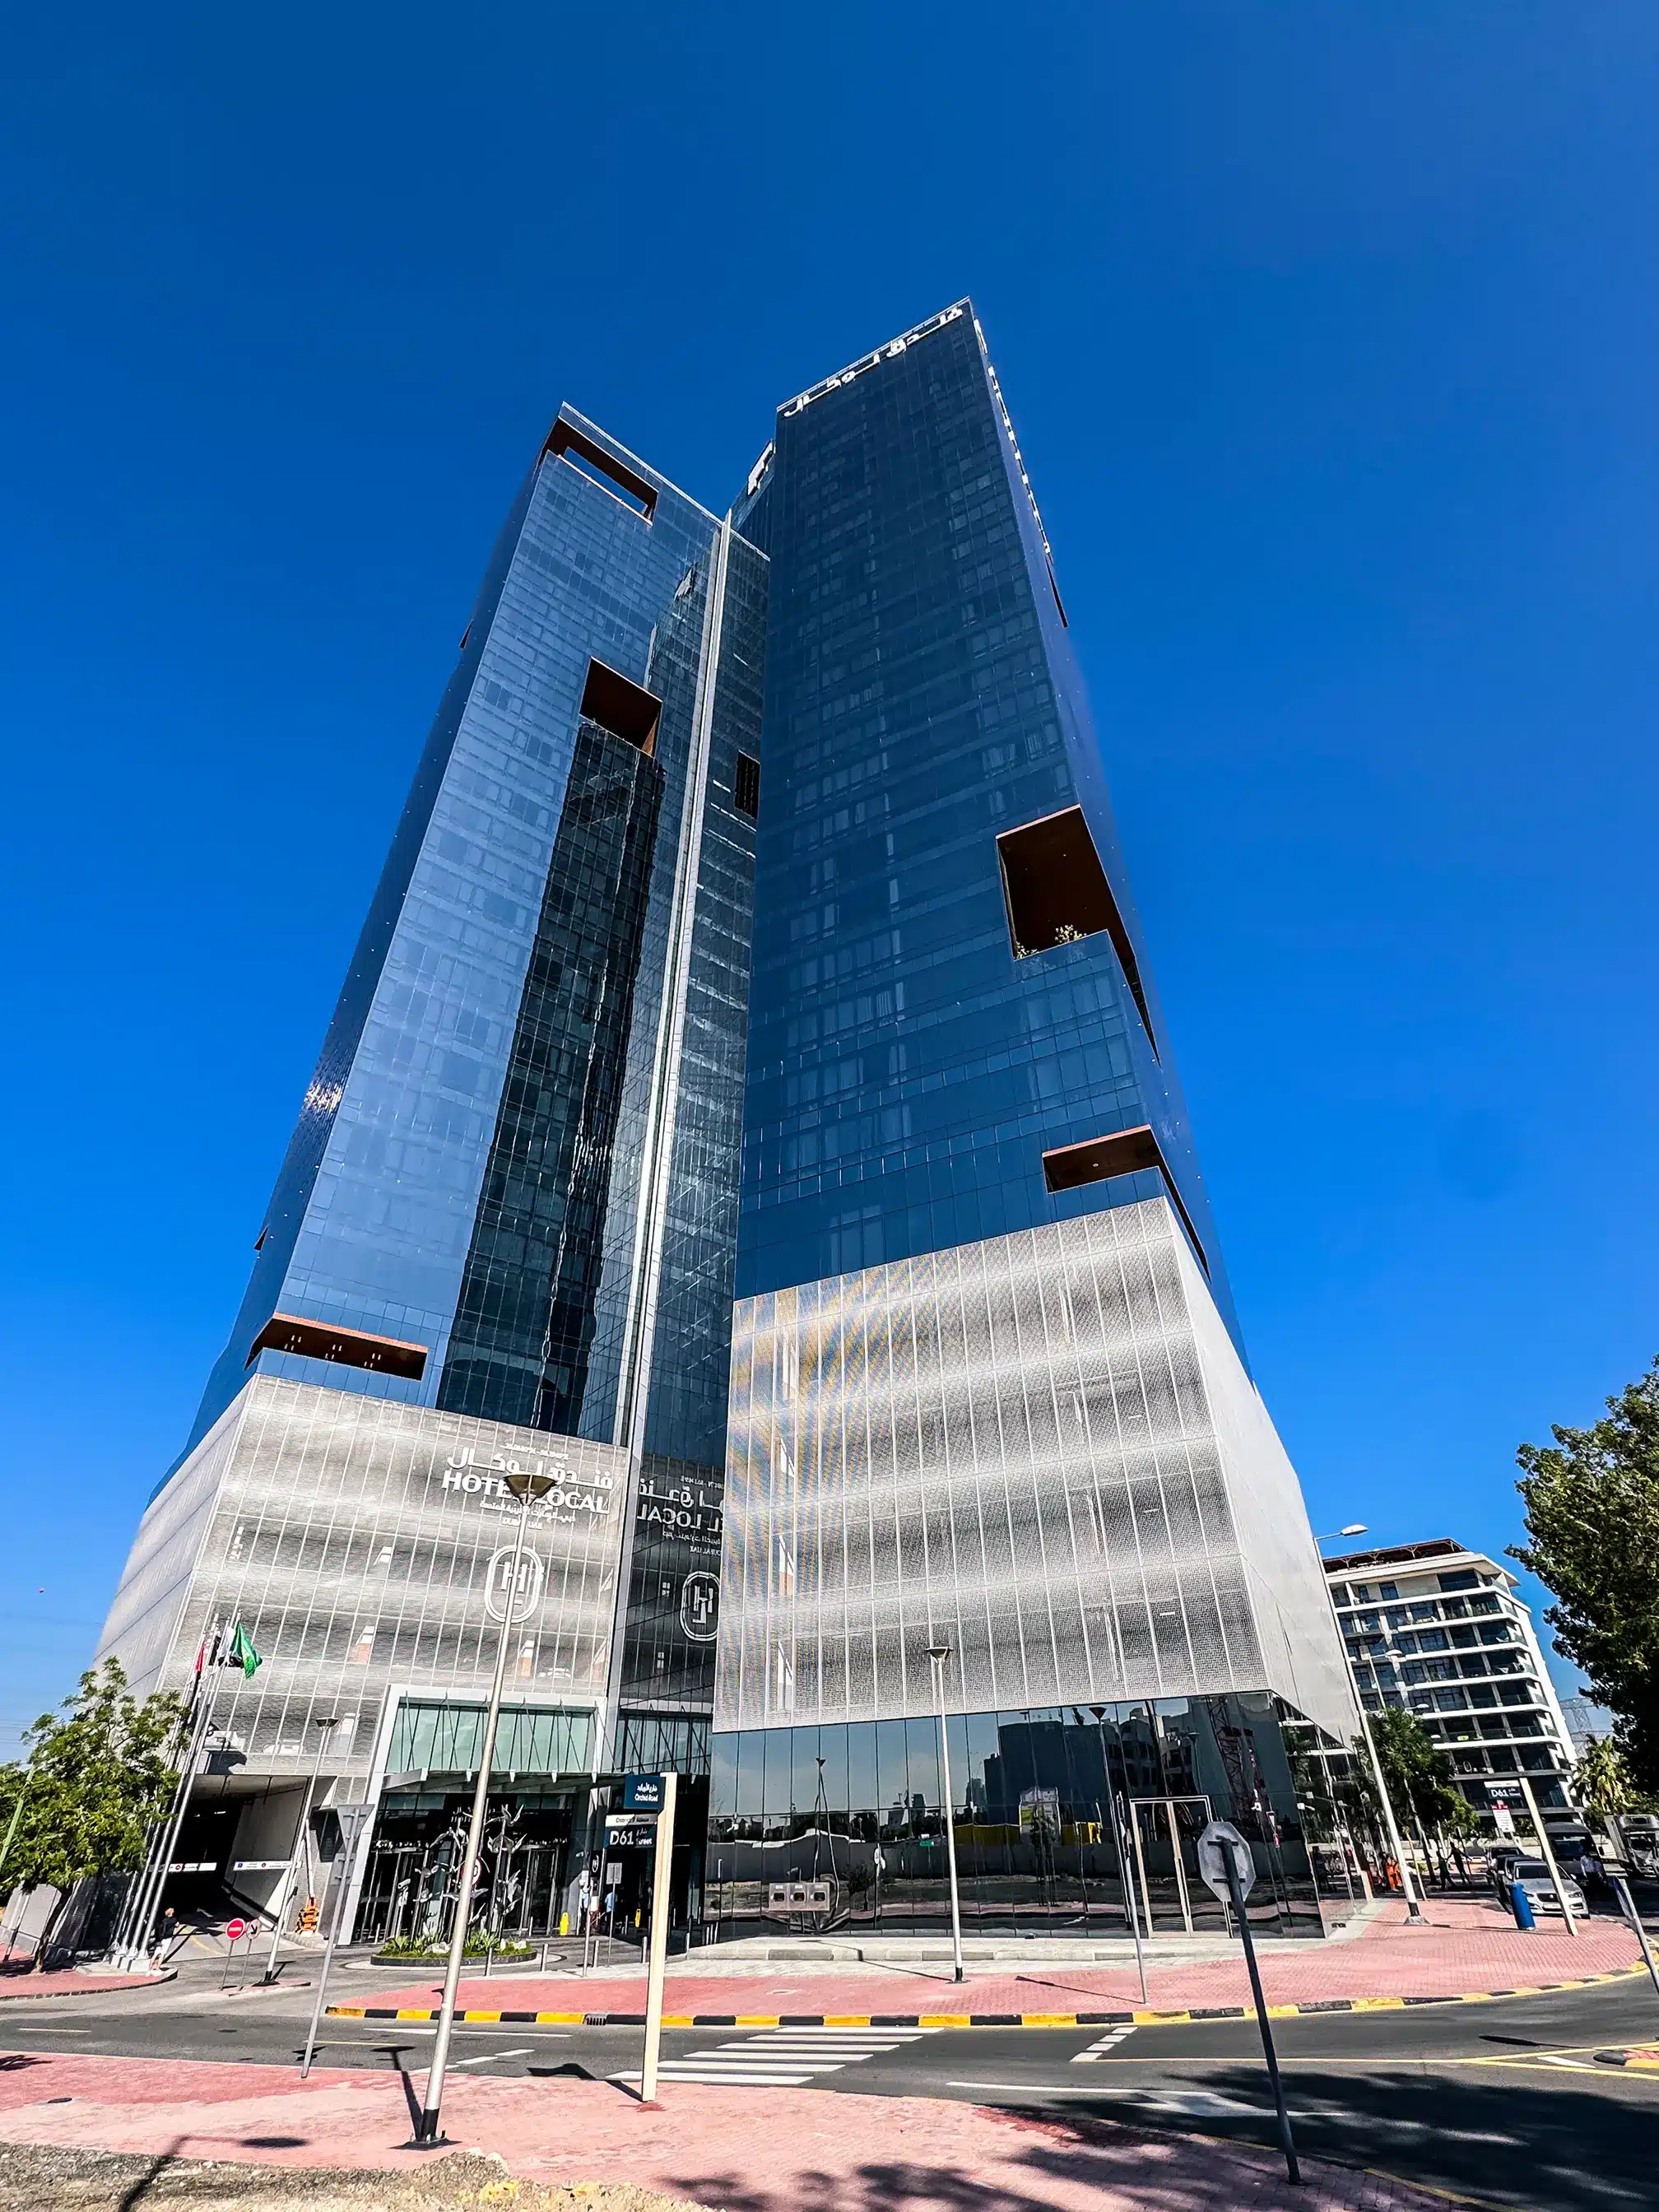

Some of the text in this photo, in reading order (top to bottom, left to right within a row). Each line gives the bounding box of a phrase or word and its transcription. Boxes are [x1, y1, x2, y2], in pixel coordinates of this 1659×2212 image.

[783, 307, 963, 417] فندق لوكال
[441, 1470, 520, 1501] HOTE
[548, 1462, 613, 1490] فندق
[1490, 1788, 1509, 1797] D61
[609, 1830, 634, 1845] D61
